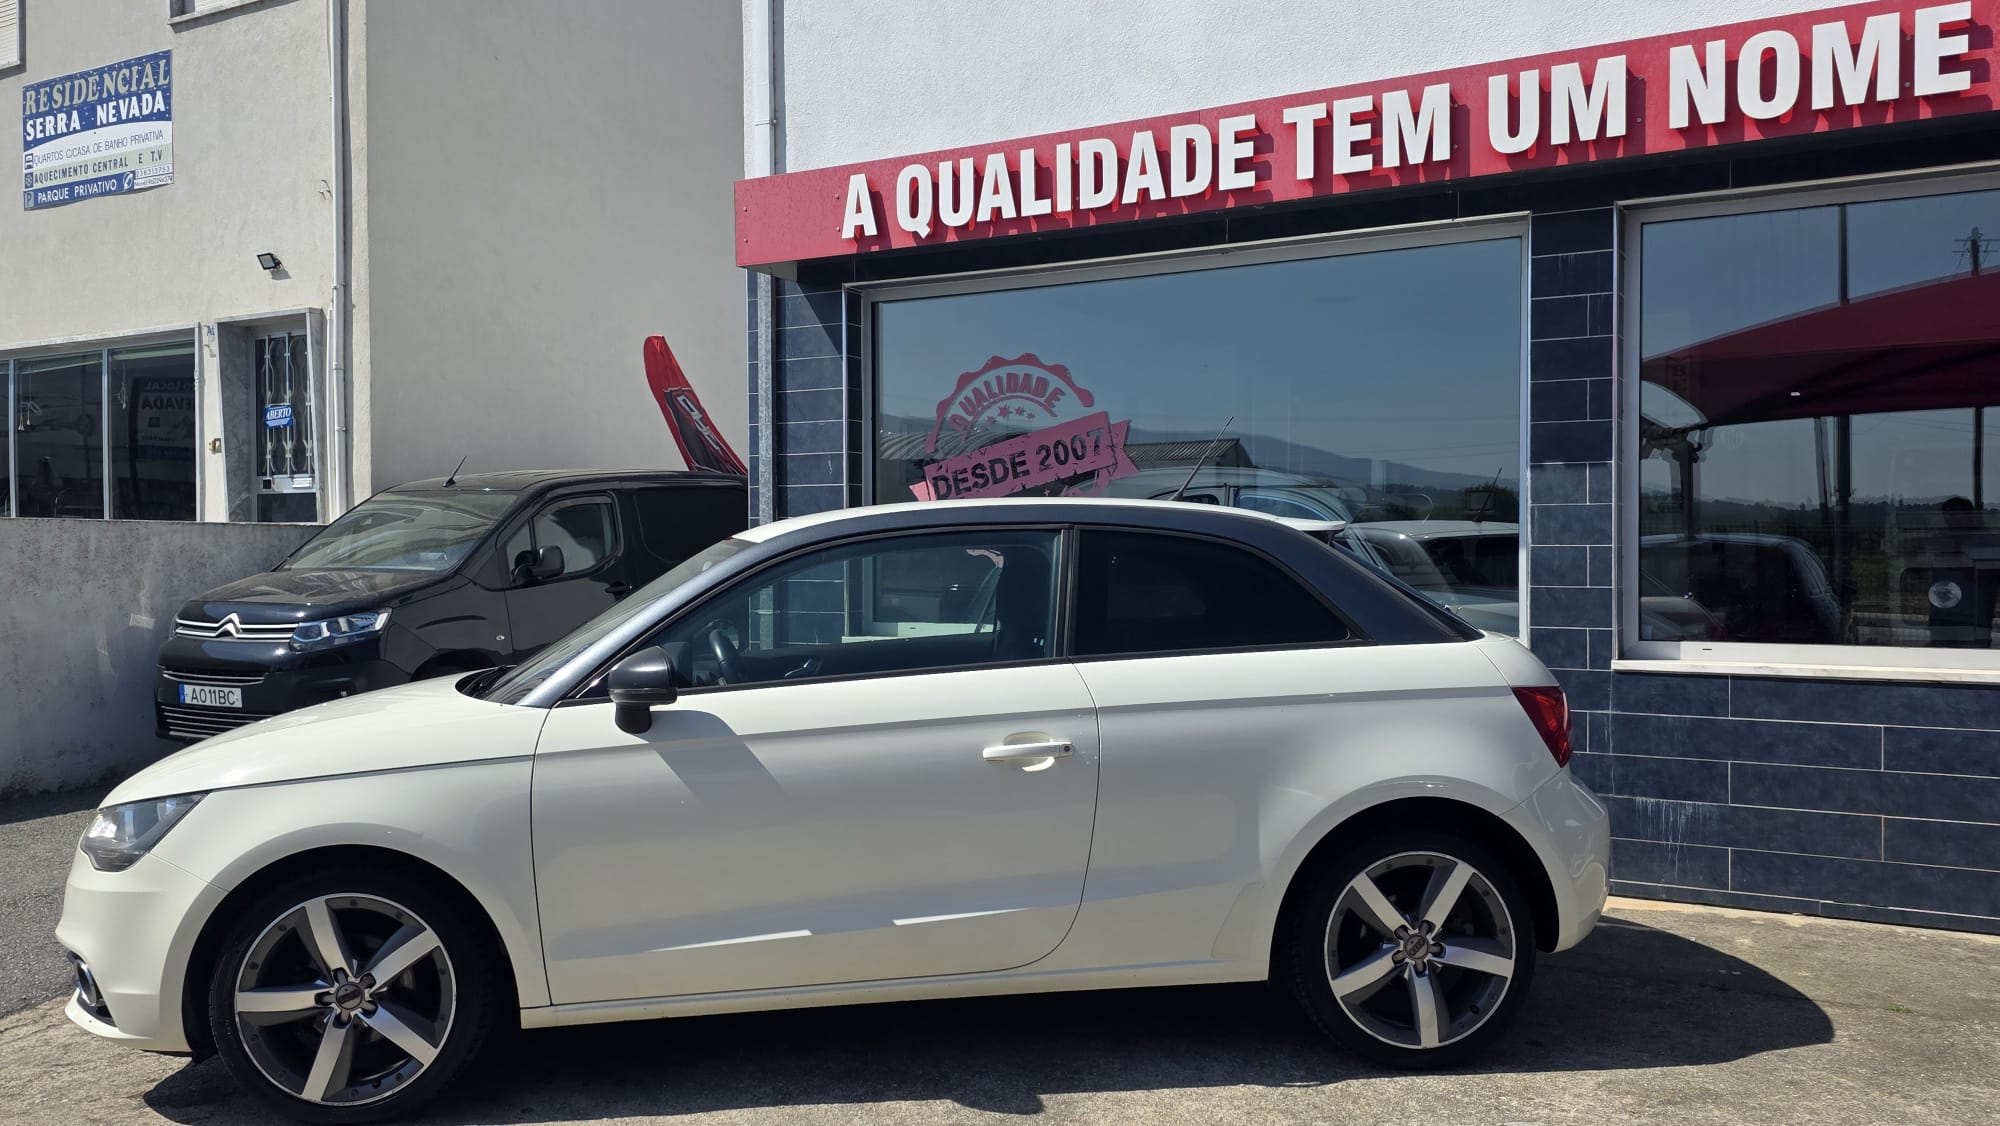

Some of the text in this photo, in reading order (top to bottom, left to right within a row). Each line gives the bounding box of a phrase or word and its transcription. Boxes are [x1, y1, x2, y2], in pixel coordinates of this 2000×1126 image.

[25, 59, 169, 115] RESIDENCIAL
[25, 91, 165, 141] SERRA NEVADA
[841, 1, 1971, 239] A QUALIDADE TEM UM NOME
[34, 149, 63, 166] QUARTOS
[93, 142, 103, 153] DE
[105, 136, 128, 151] BANHO
[130, 130, 163, 146] PRIVATIVA
[34, 164, 89, 185] AQUECIMENTO
[93, 157, 128, 174] CENTRAL
[138, 153, 143, 164] E
[38, 187, 69, 204] PARQUE
[74, 179, 117, 197] PRIVATIVO
[266, 407, 292, 420] ABERTO
[950, 372, 1066, 433] QUALIDADE
[932, 427, 1105, 499] DESDE 2007
